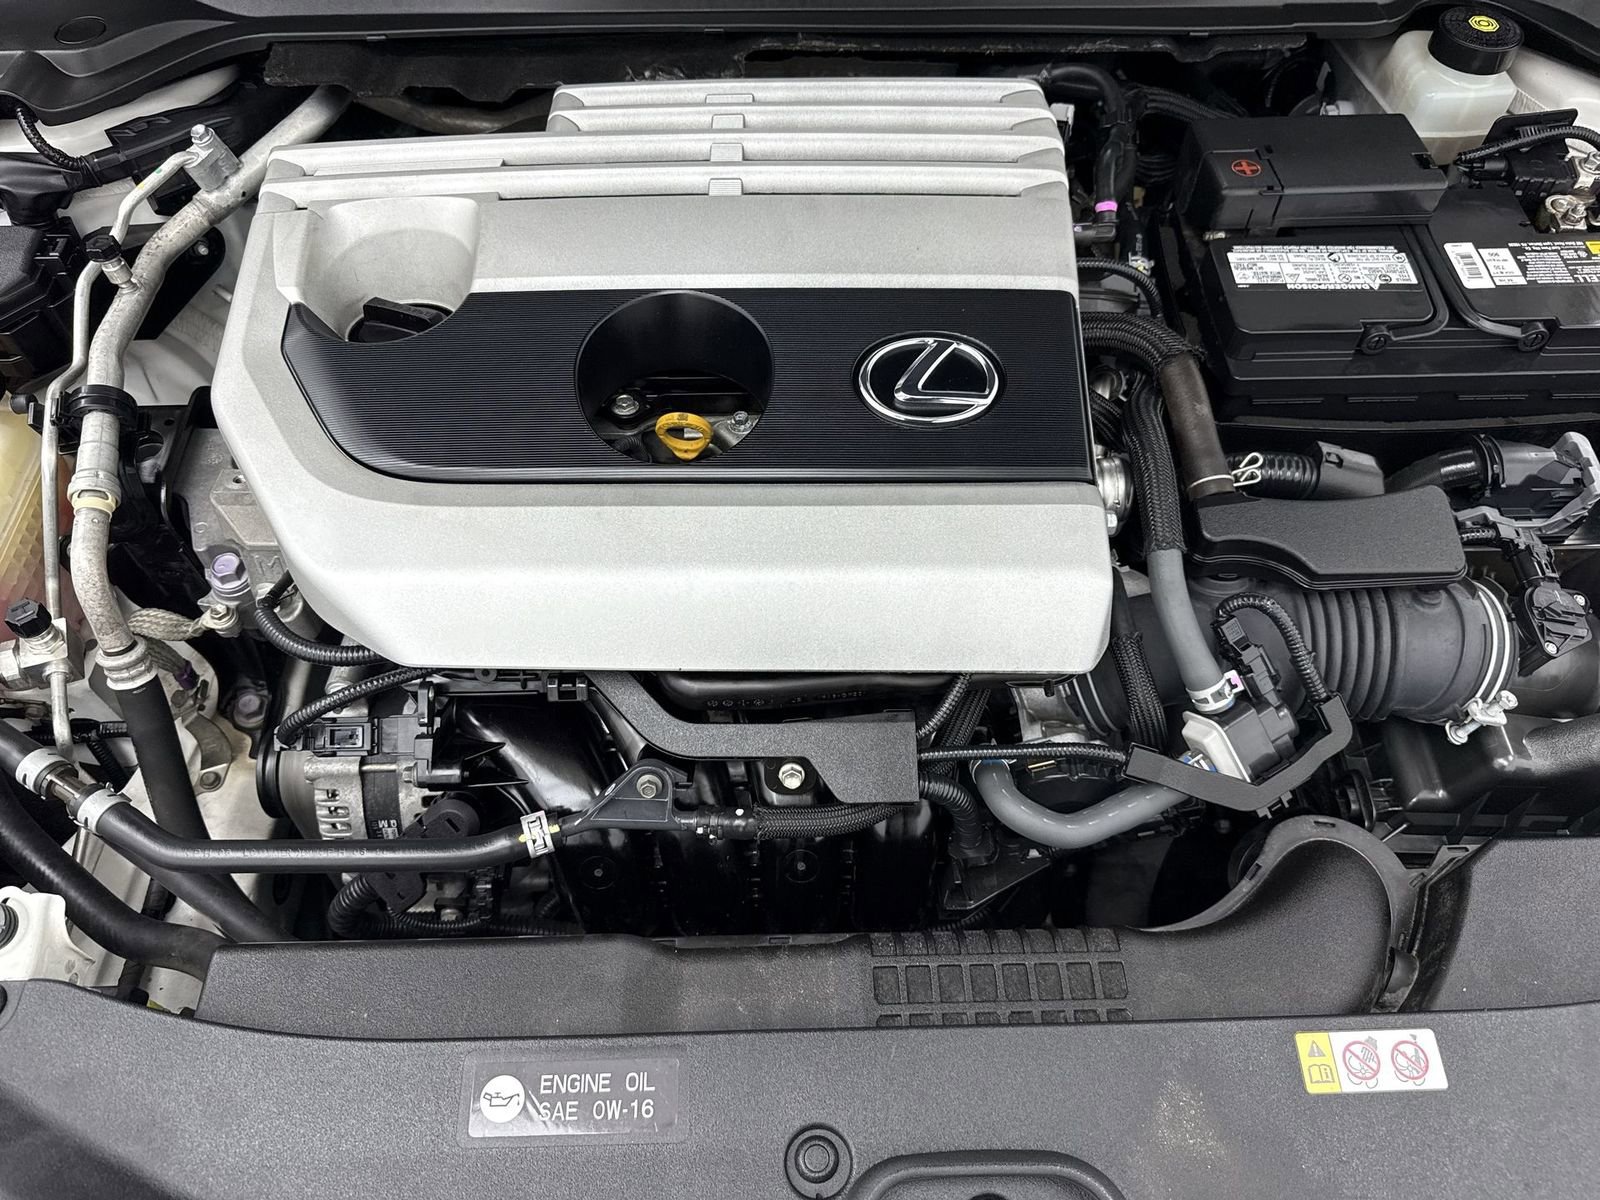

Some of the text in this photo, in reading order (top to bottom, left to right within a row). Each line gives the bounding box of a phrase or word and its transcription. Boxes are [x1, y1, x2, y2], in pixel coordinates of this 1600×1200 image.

[1574, 275, 1600, 284] ELL
[540, 1071, 656, 1094] ENGINE OIL
[540, 1099, 654, 1121] SAE 0W-16
